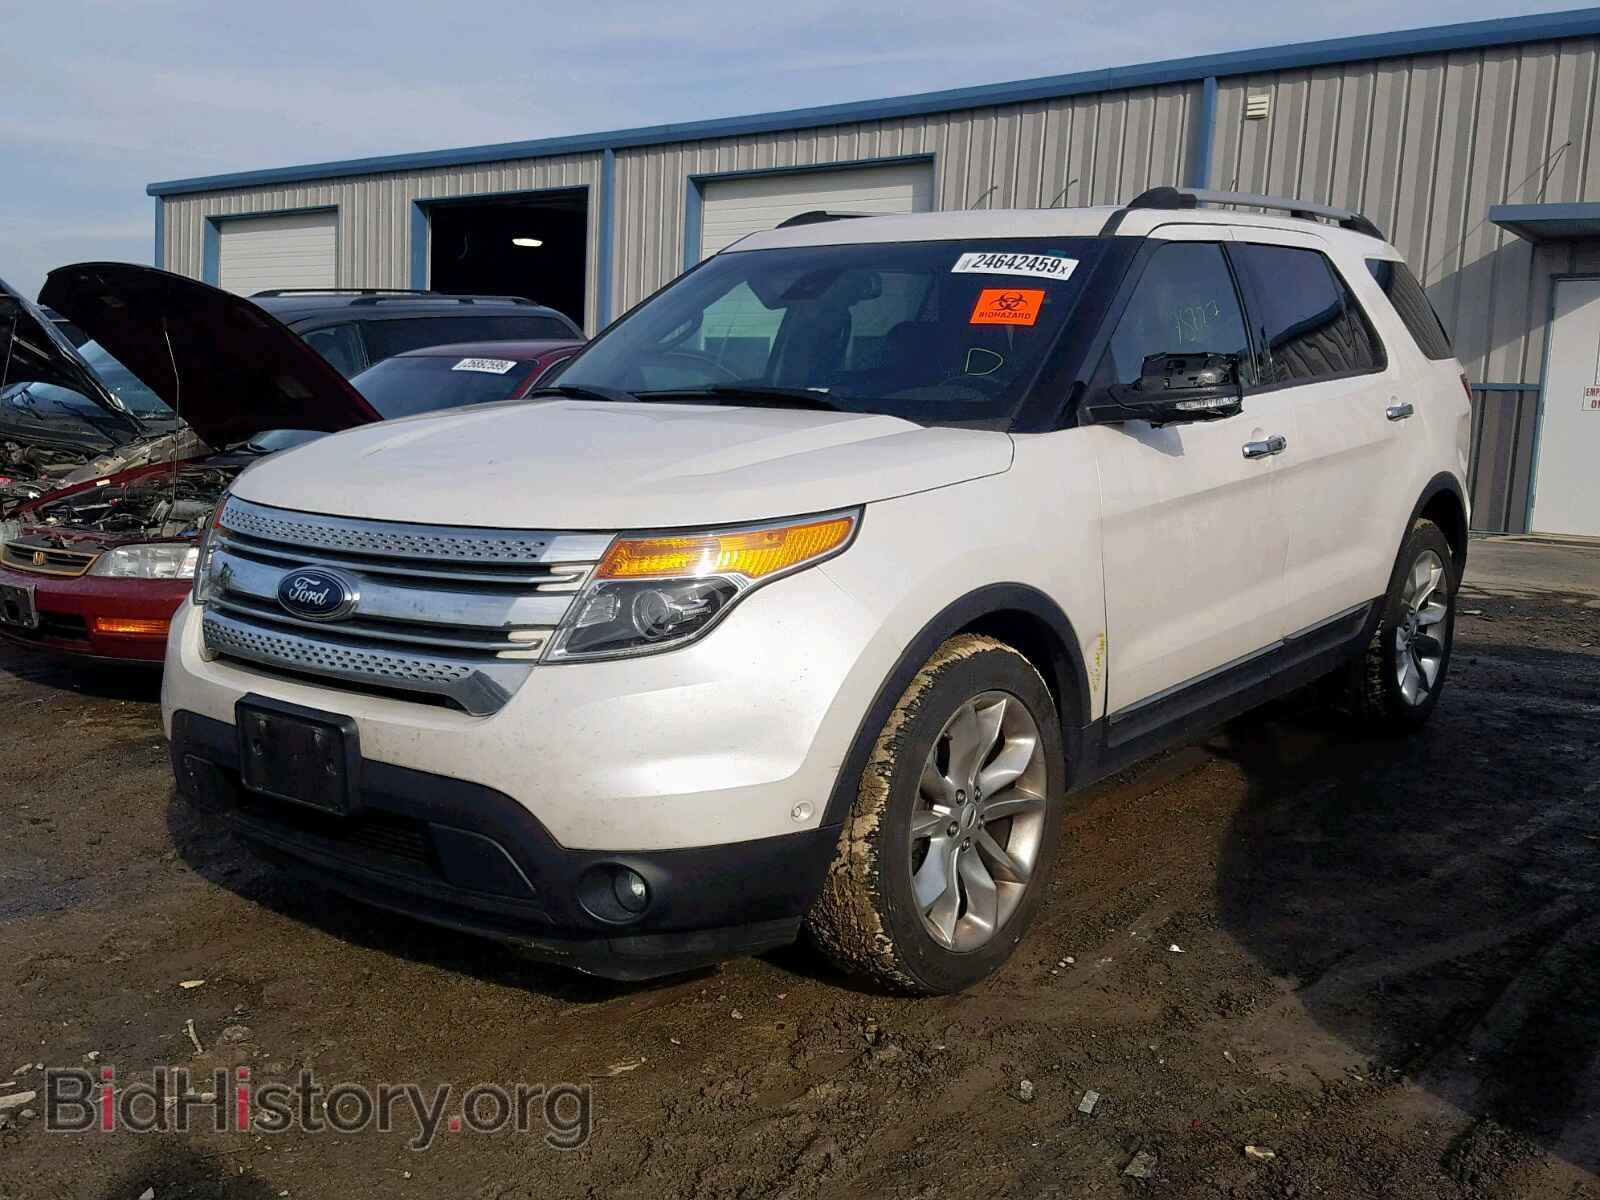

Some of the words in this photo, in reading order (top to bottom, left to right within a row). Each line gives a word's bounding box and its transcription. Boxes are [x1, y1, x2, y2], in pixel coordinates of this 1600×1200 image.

[971, 254, 1061, 274] 24642459
[978, 311, 1031, 320] BIOHAZARD
[964, 348, 1004, 376] D
[288, 576, 330, 606] Ford
